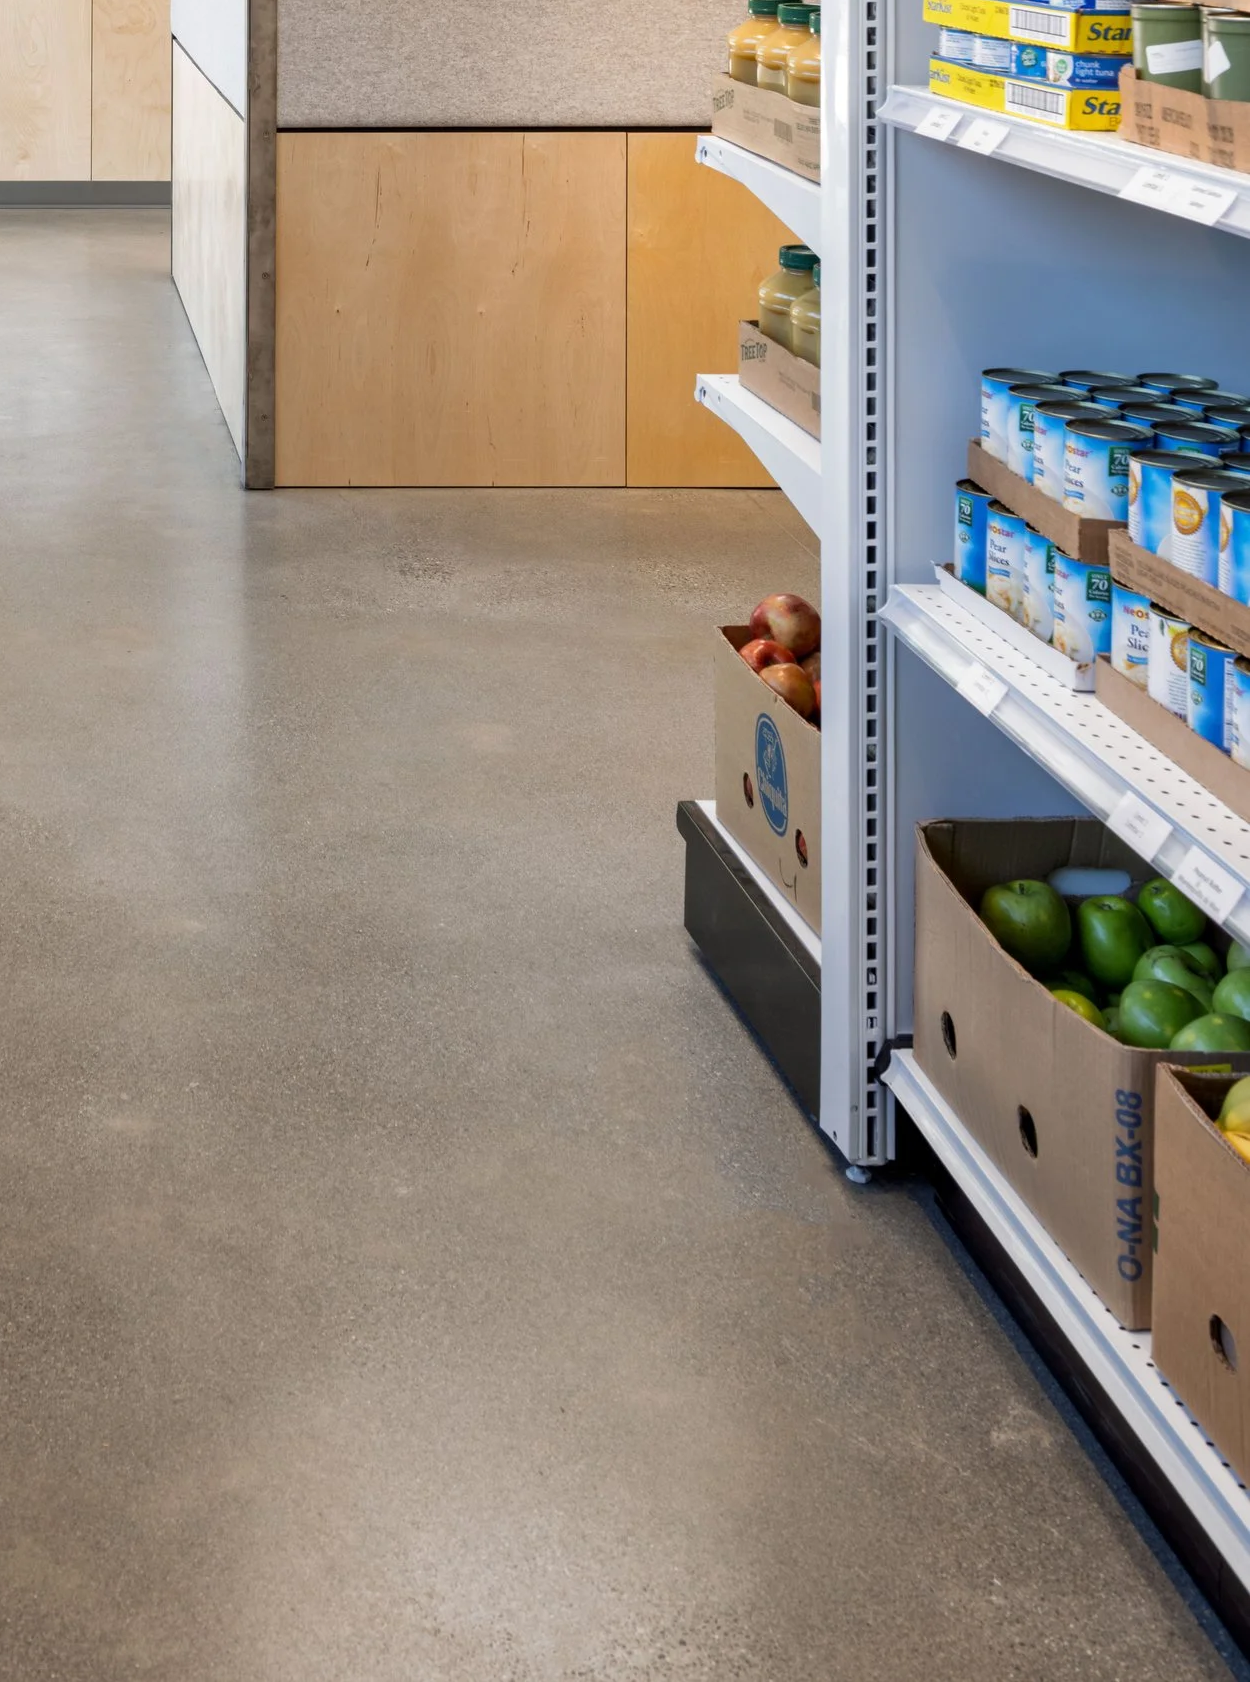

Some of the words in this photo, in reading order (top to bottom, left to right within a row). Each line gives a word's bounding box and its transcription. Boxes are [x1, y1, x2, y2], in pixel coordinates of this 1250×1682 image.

[1086, 22, 1133, 42] Star
[1074, 60, 1101, 69] chunk
[1074, 68, 1094, 78] light
[1094, 69, 1115, 77] tuna
[959, 503, 971, 516] 70
[989, 538, 1008, 554] Pear
[1090, 579, 1109, 591] 70
[1190, 656, 1205, 672] 70
[758, 765, 788, 819] Chiquita
[1114, 1088, 1144, 1188] BX-08
